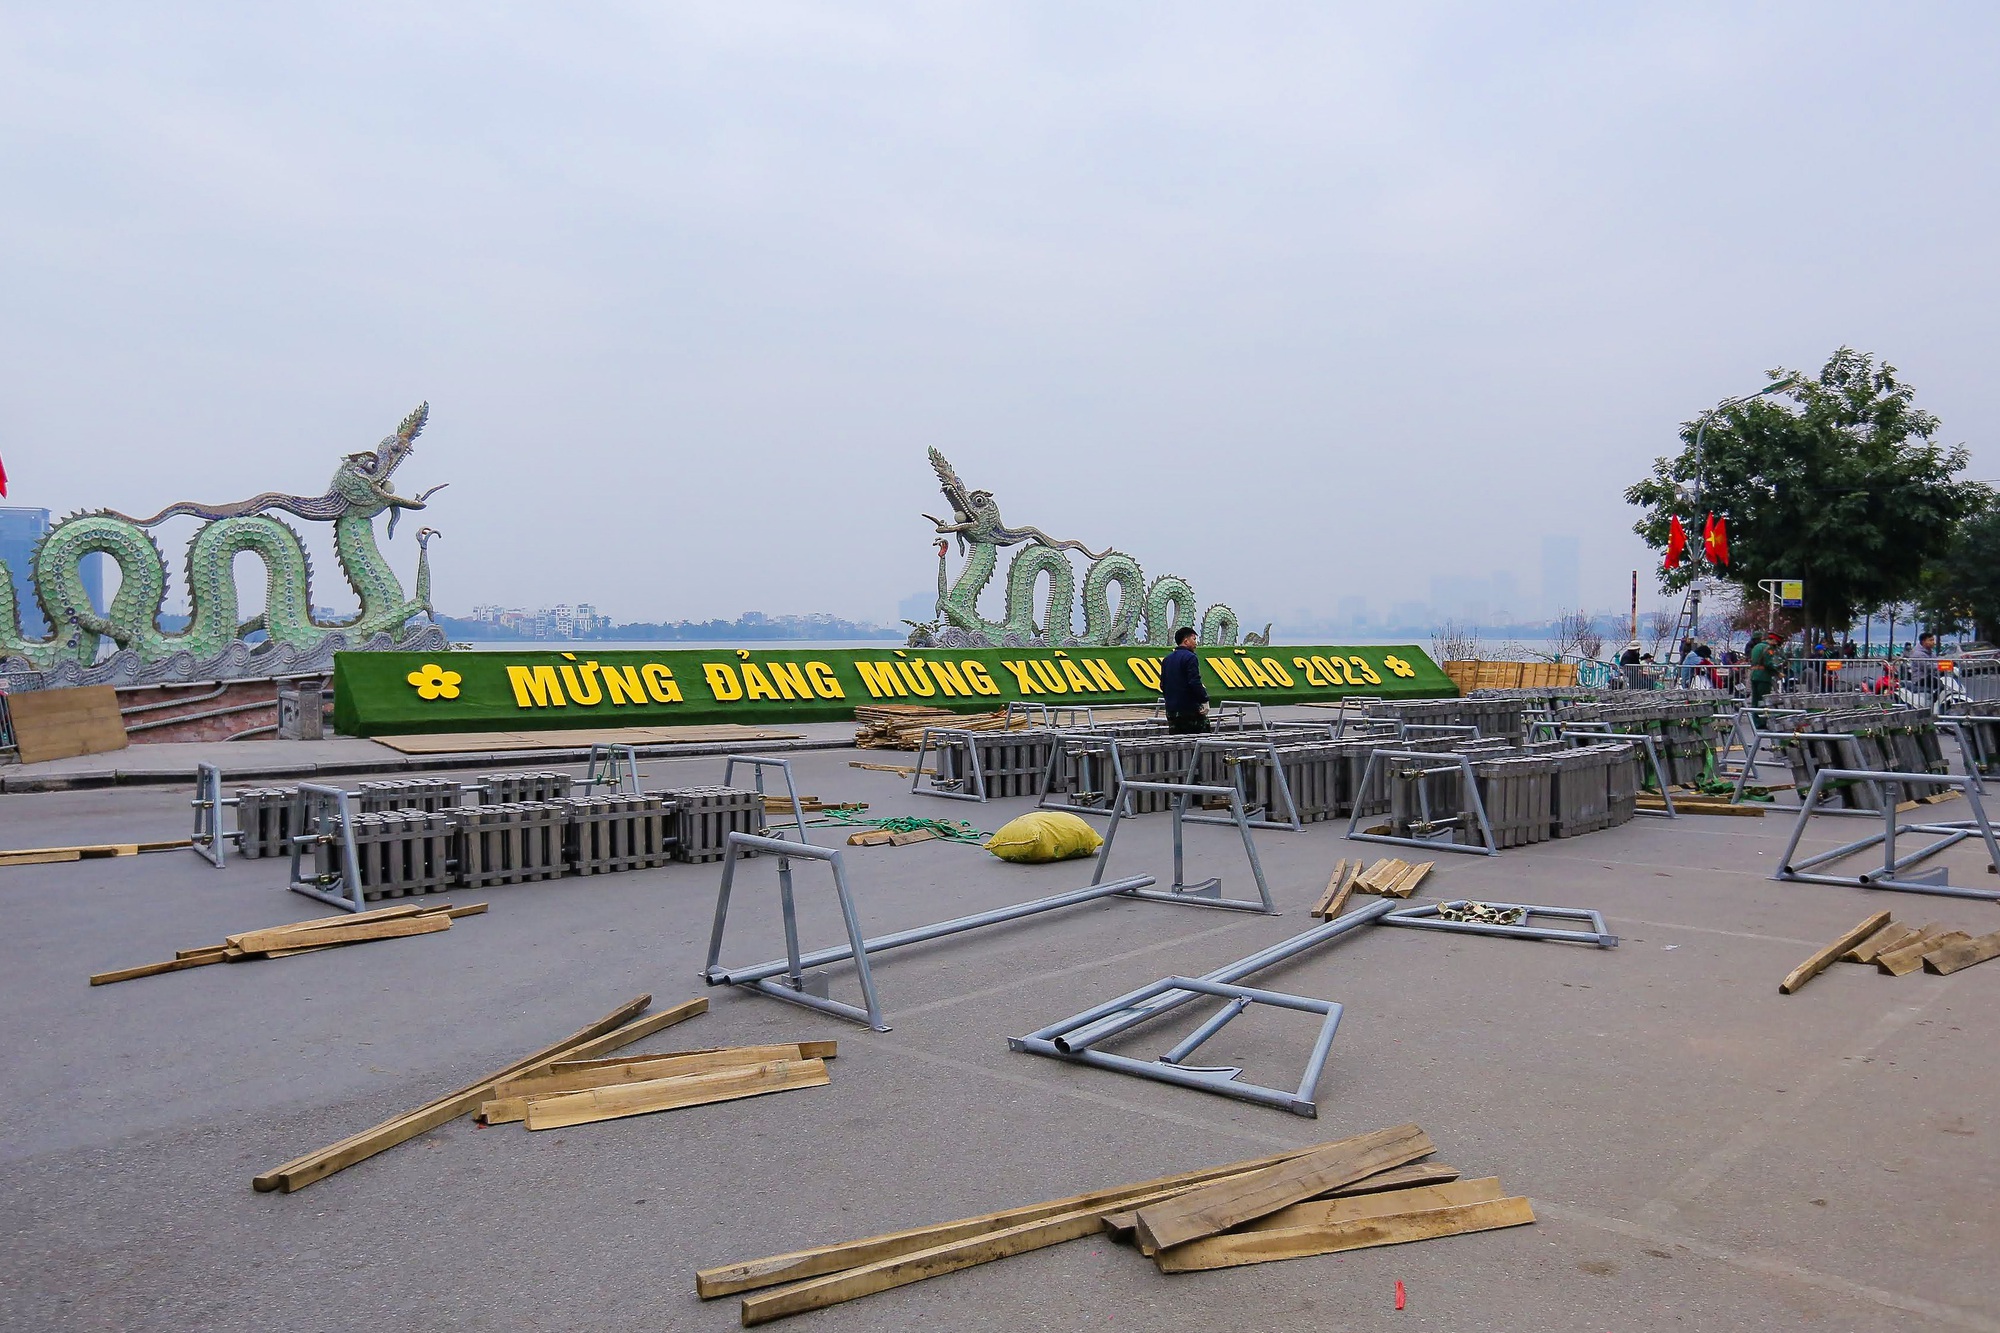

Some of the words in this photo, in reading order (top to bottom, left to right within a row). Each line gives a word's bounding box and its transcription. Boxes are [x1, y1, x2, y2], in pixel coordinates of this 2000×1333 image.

[506, 651, 683, 707] MỪNG
[703, 648, 845, 701] ĐẢNG
[855, 649, 1000, 698] MỪNG
[1002, 650, 1125, 694] XUÂN
[1206, 648, 1295, 688] MÃO
[1294, 656, 1382, 686] 2023
